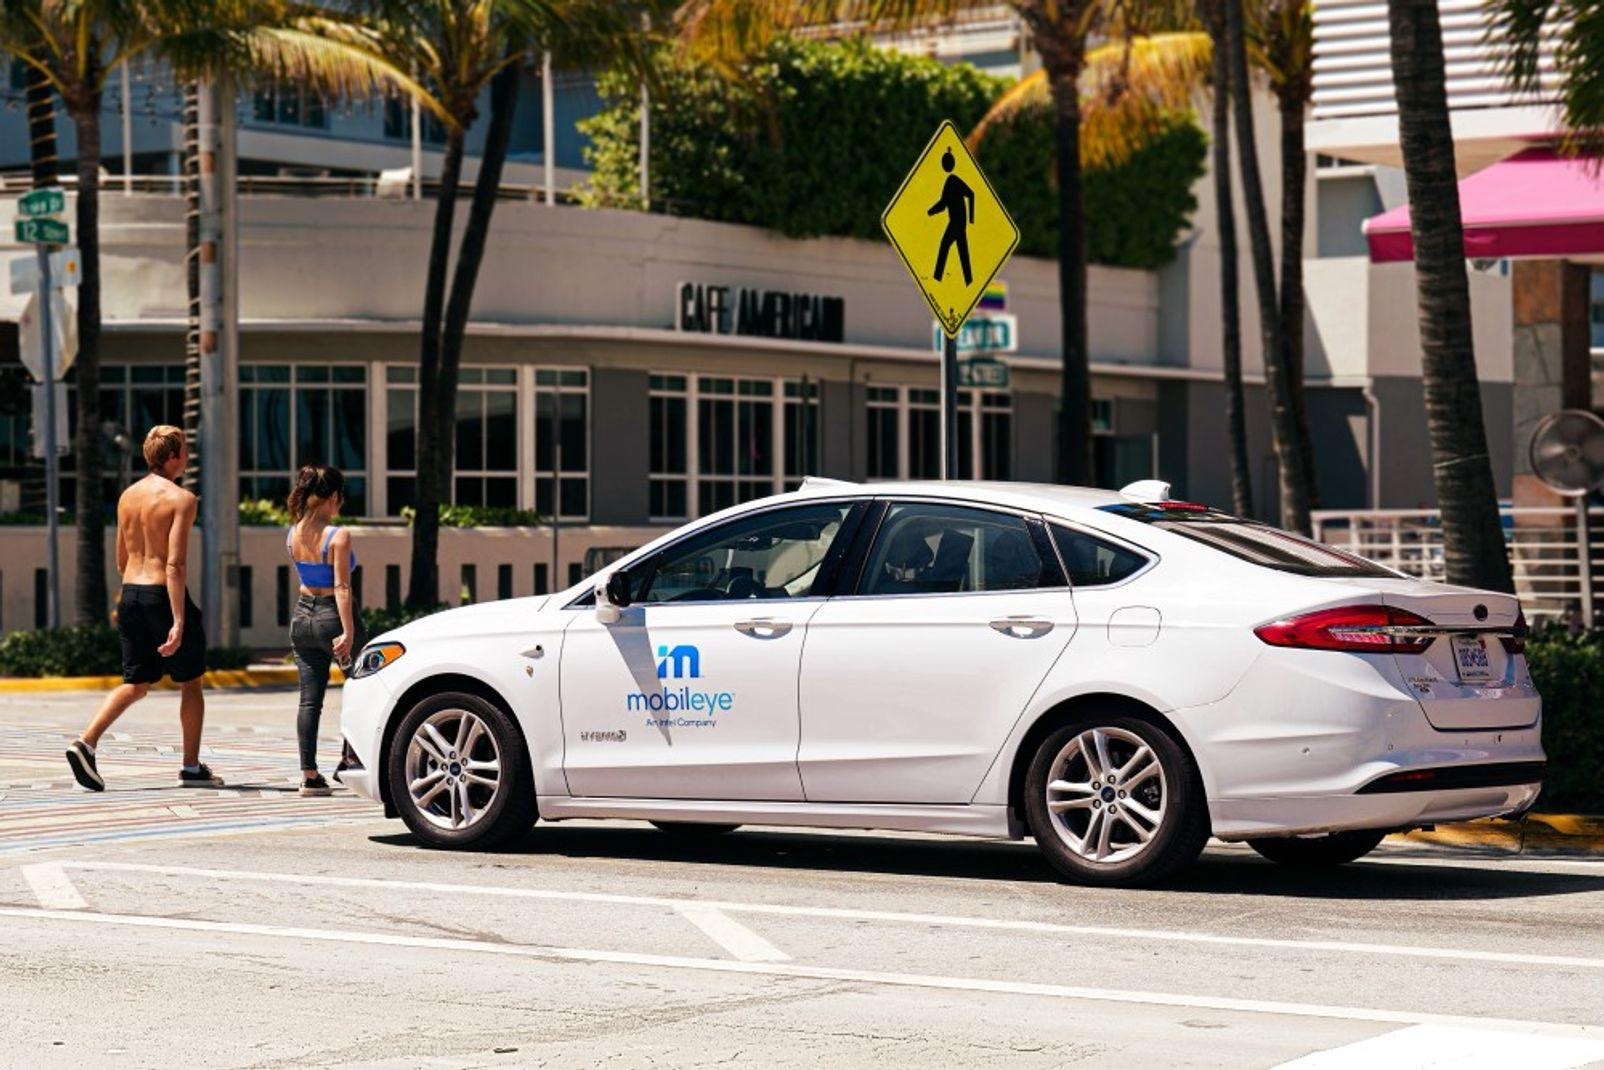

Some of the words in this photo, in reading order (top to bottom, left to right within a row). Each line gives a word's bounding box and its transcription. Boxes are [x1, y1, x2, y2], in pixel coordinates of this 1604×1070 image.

[23, 222, 38, 241] 12
[681, 283, 731, 334] CAFE
[627, 687, 733, 716] mobileye
[646, 717, 658, 727] An
[660, 717, 676, 727] Intel
[677, 717, 717, 729] Company
